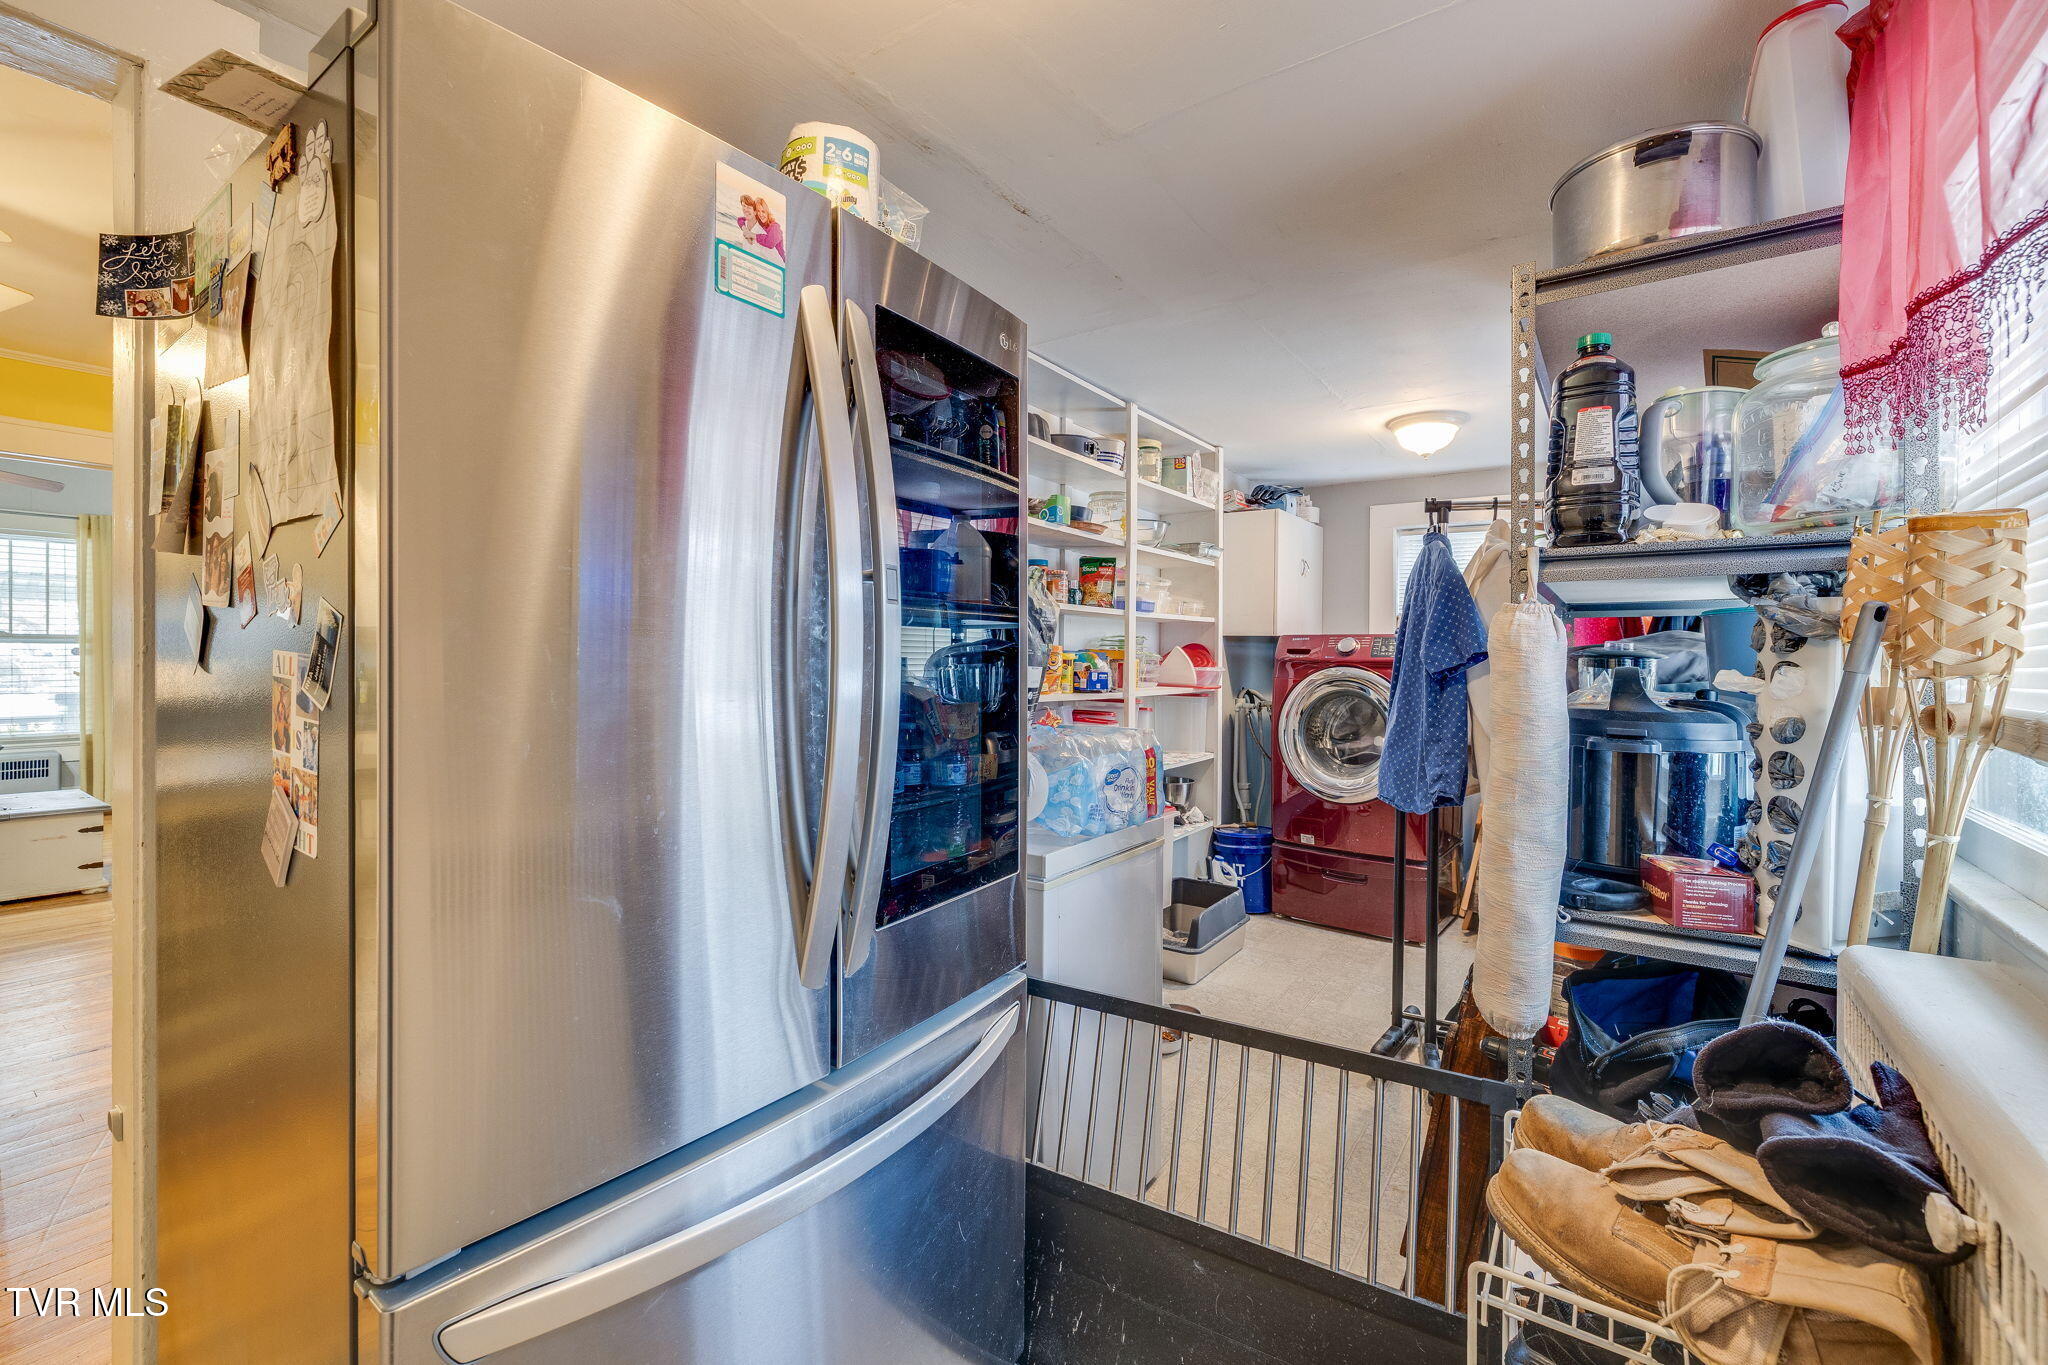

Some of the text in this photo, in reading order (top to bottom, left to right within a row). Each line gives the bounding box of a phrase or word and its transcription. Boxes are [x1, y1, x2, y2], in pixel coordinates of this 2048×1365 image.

[102, 236, 165, 270] Let
[147, 252, 173, 269] it
[118, 261, 180, 288] Snow
[276, 653, 295, 677] ALL
